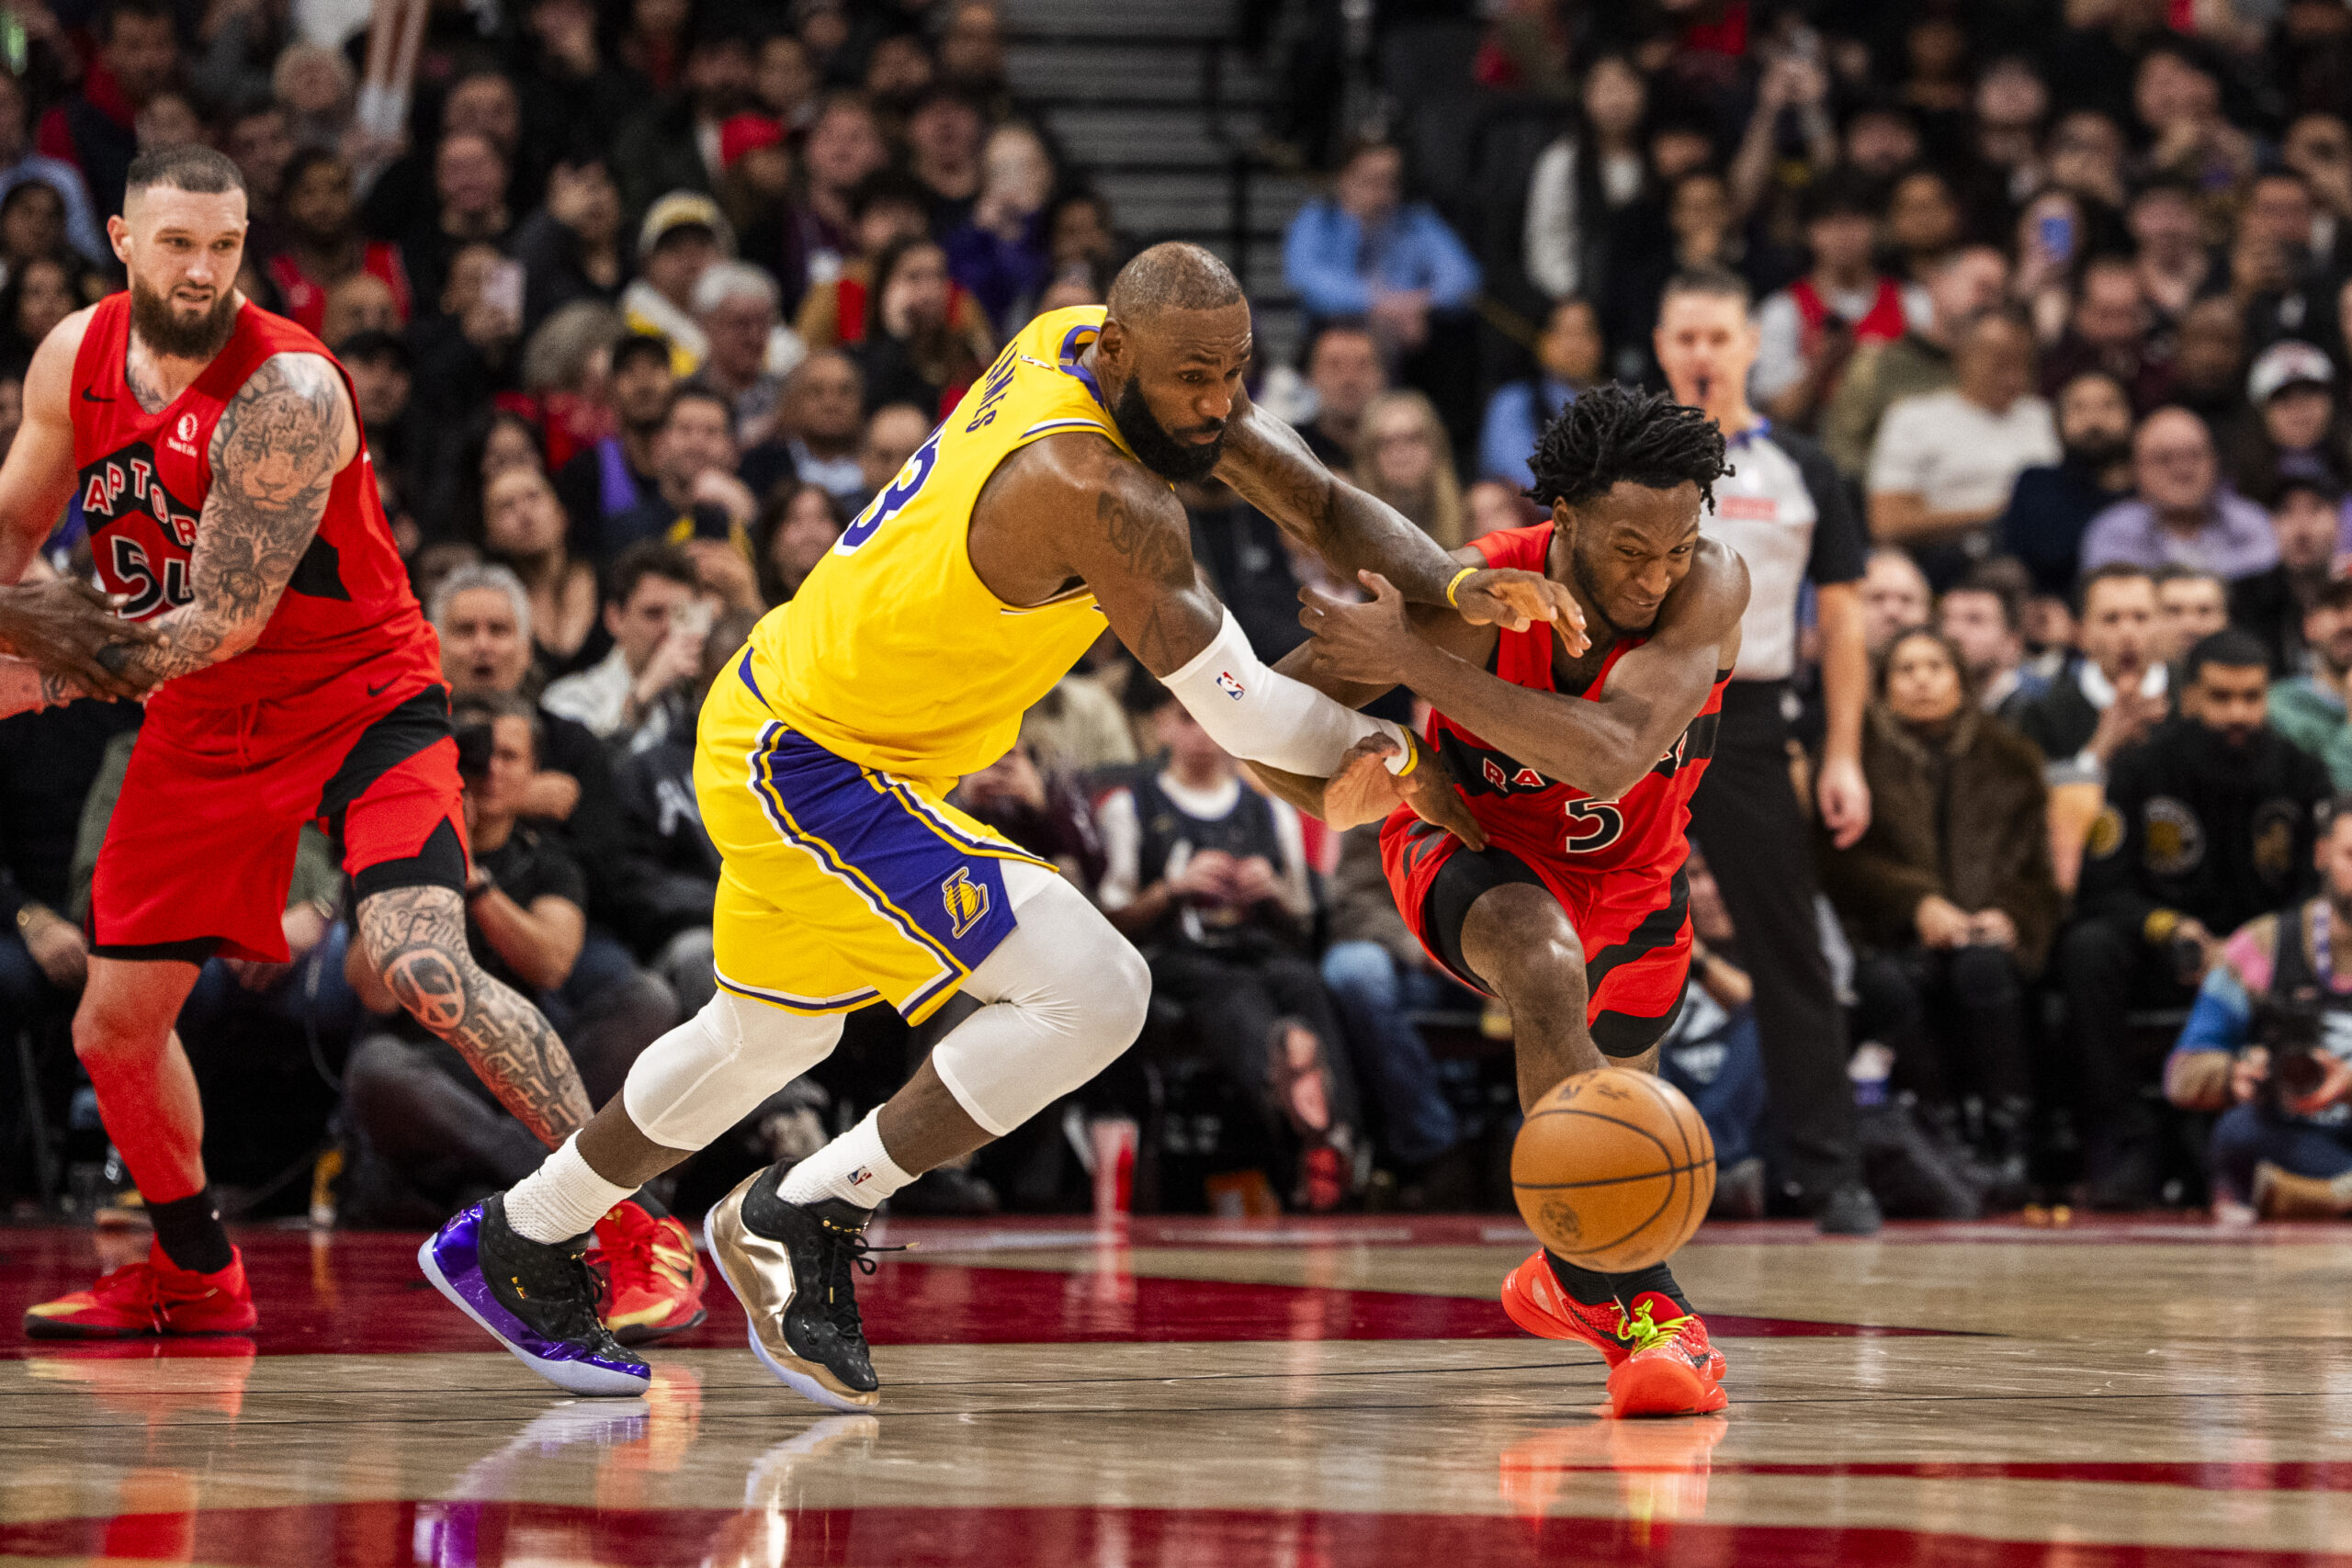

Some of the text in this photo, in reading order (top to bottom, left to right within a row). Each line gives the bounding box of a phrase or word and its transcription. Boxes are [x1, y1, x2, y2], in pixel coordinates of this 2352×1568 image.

[82, 458, 198, 547] APTOR
[832, 413, 953, 557] 3
[1565, 795, 1624, 854] 5
